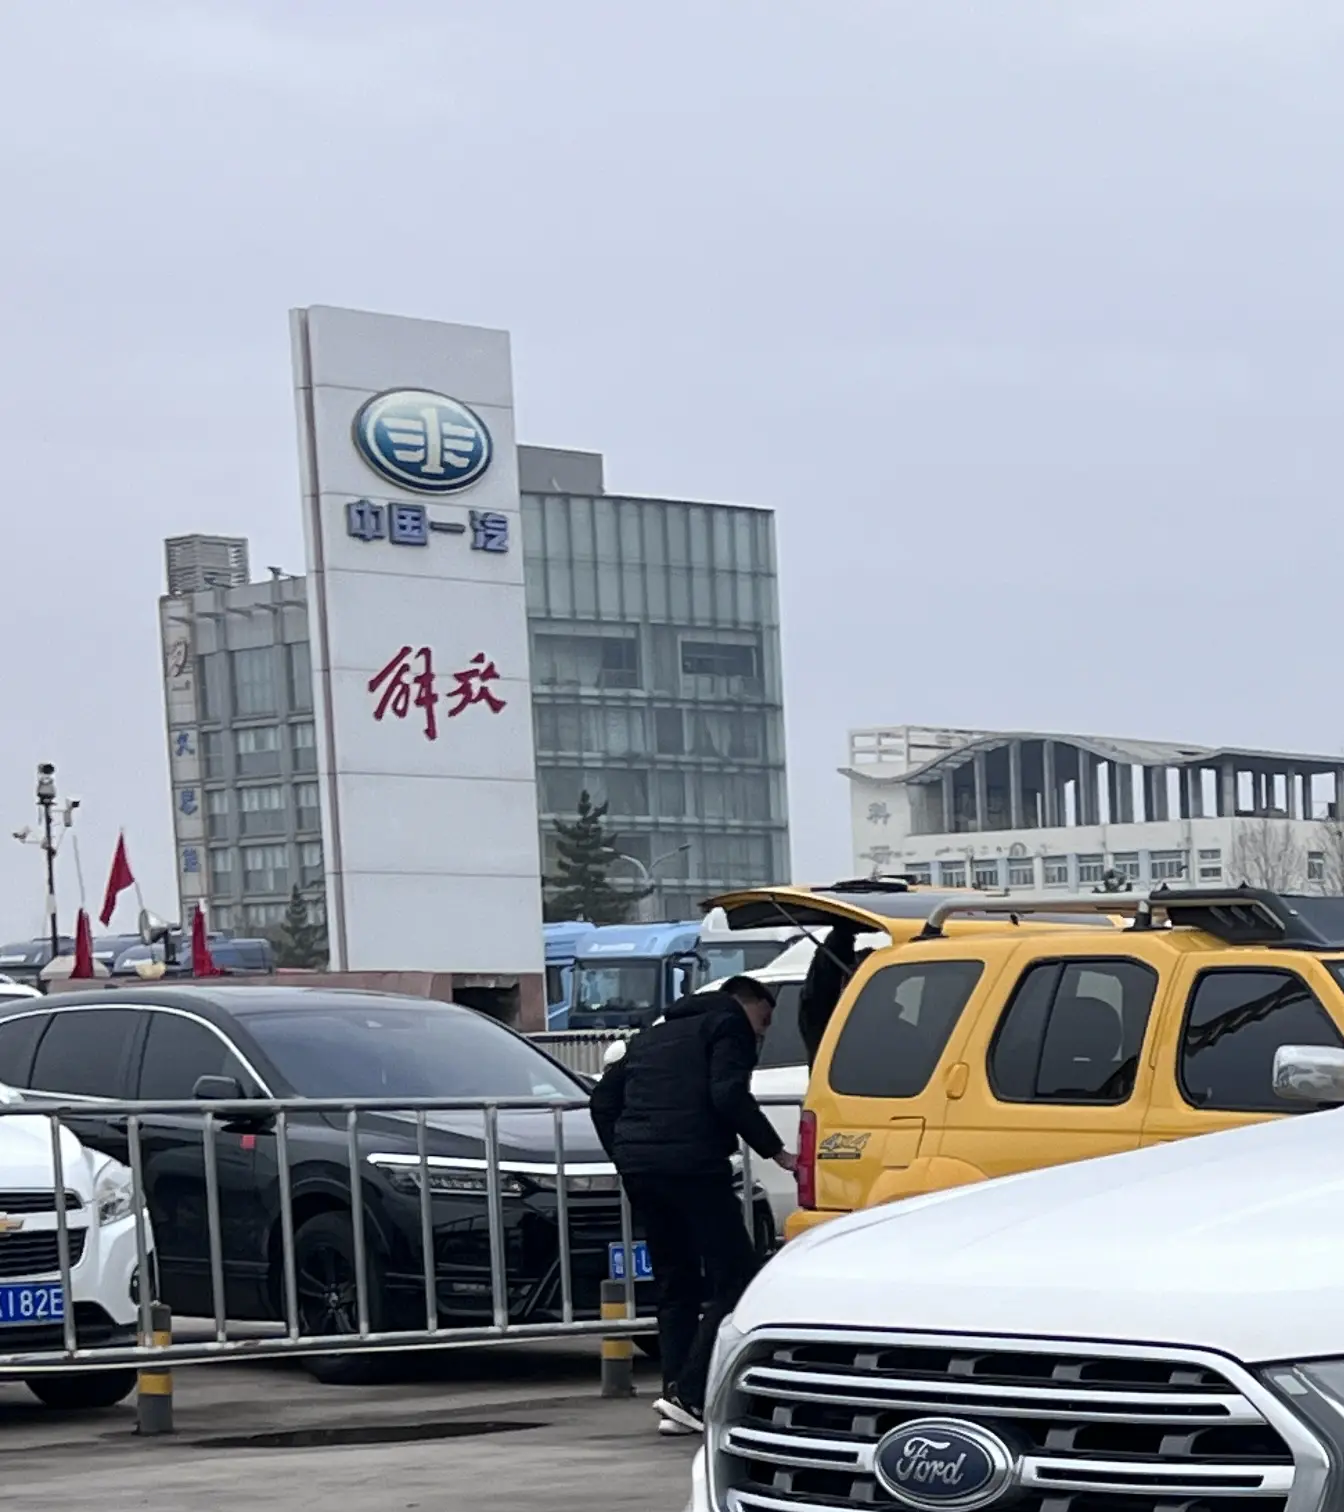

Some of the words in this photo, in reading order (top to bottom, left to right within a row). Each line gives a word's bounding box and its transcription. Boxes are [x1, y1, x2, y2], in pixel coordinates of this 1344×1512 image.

[346, 500, 509, 553] 中国一汽
[367, 645, 508, 741] 解放
[0, 1288, 65, 1318] 182E
[896, 1436, 968, 1485] Ford
